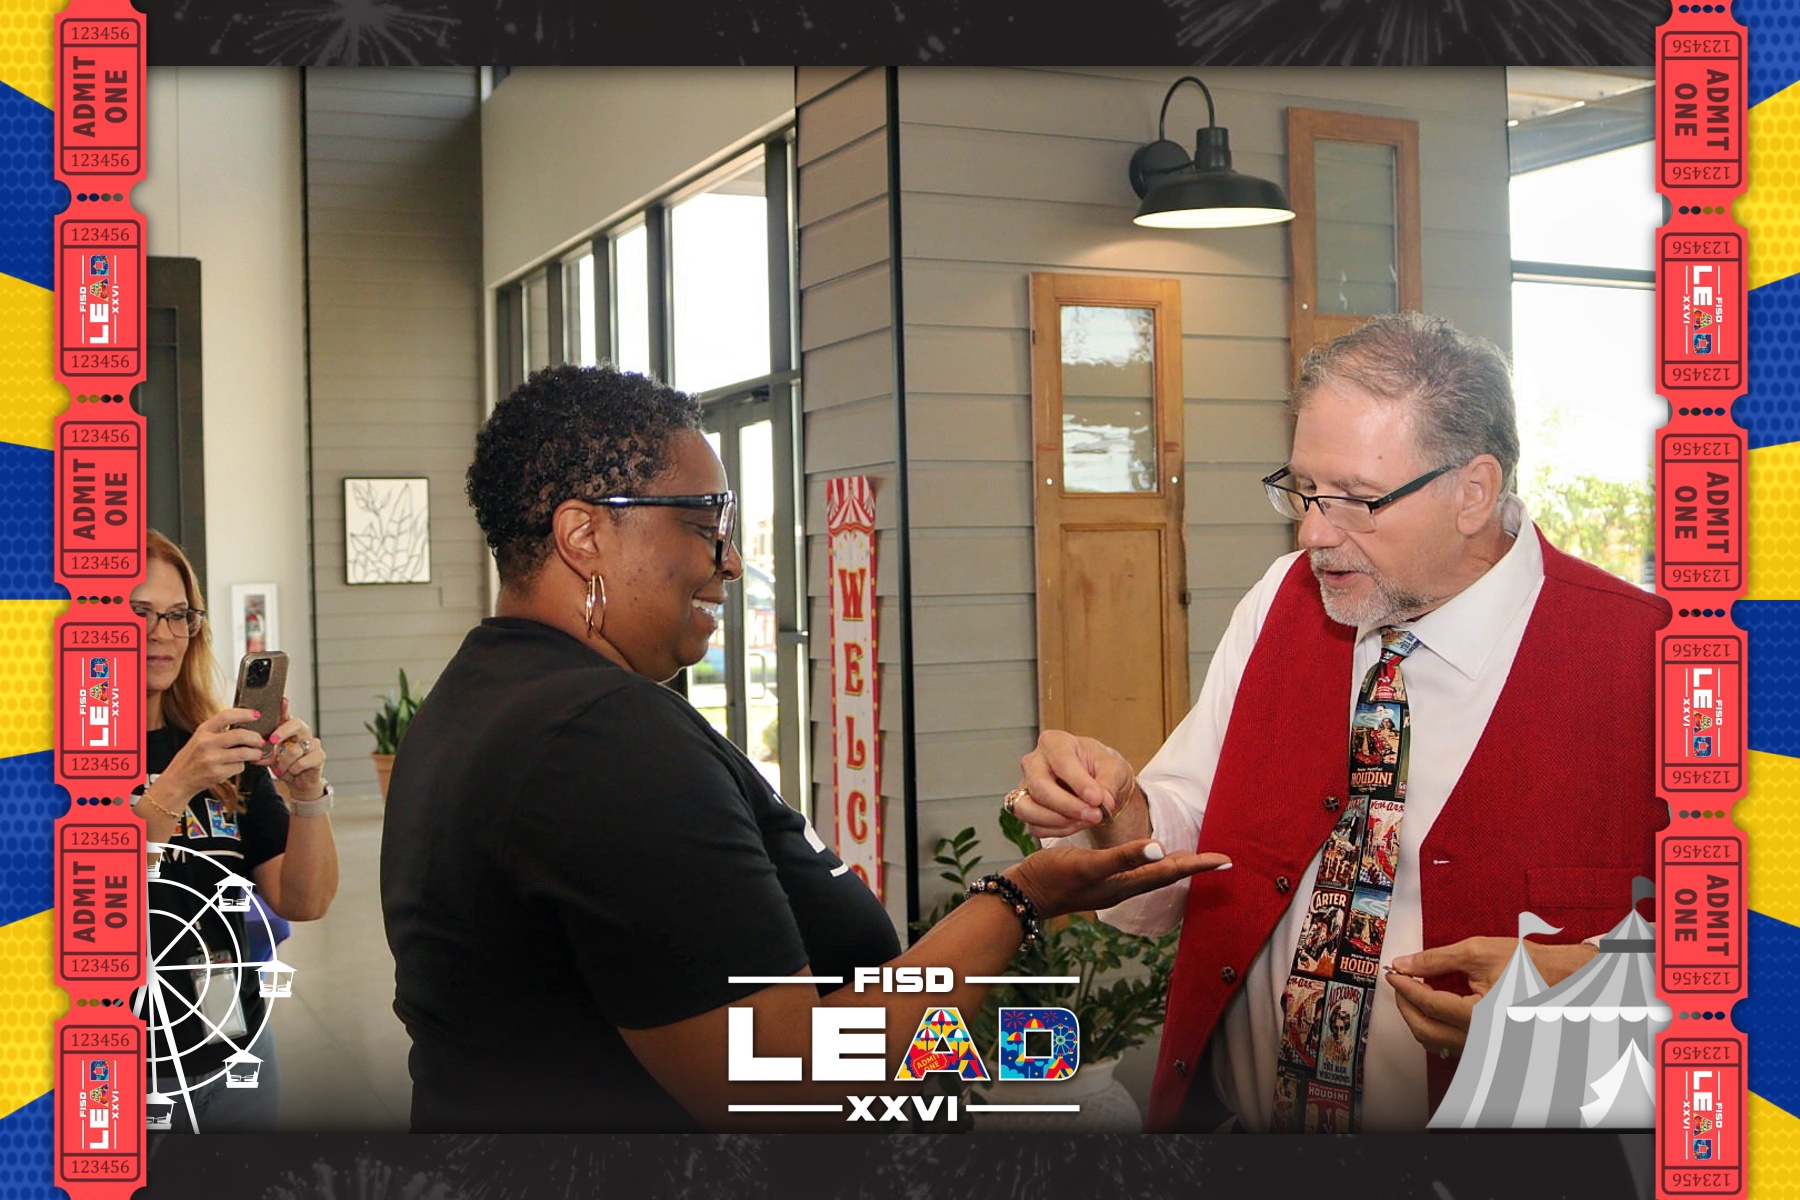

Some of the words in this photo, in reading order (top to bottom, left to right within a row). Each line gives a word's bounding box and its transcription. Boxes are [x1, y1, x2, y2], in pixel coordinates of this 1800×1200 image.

[838, 567, 869, 888] WELC
[1351, 771, 1394, 786] HOUDINI
[1310, 890, 1347, 914] CARTER
[1308, 1086, 1348, 1101] HOUDINI
